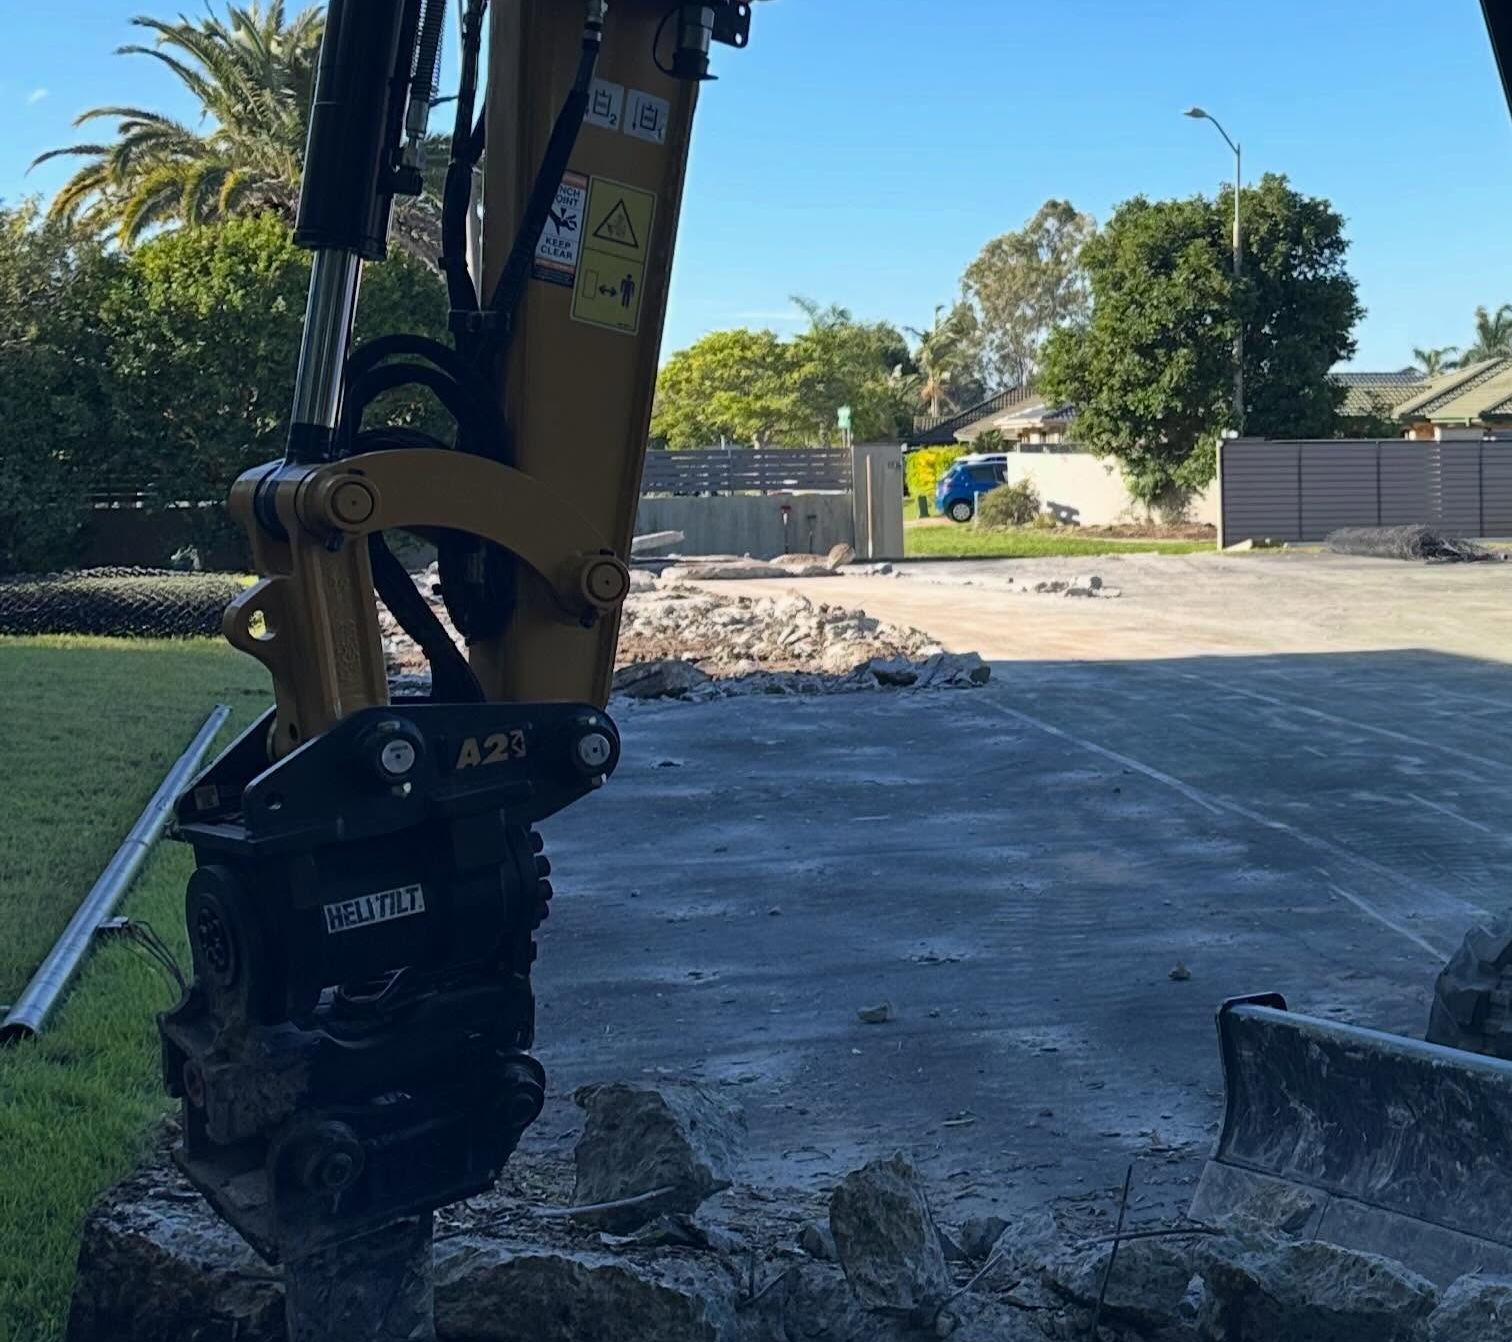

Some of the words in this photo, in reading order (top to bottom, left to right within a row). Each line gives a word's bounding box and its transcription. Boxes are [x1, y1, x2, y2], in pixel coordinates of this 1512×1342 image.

[555, 194, 579, 207] OINT
[545, 237, 571, 249] KEEP
[541, 245, 573, 260] CLEAR
